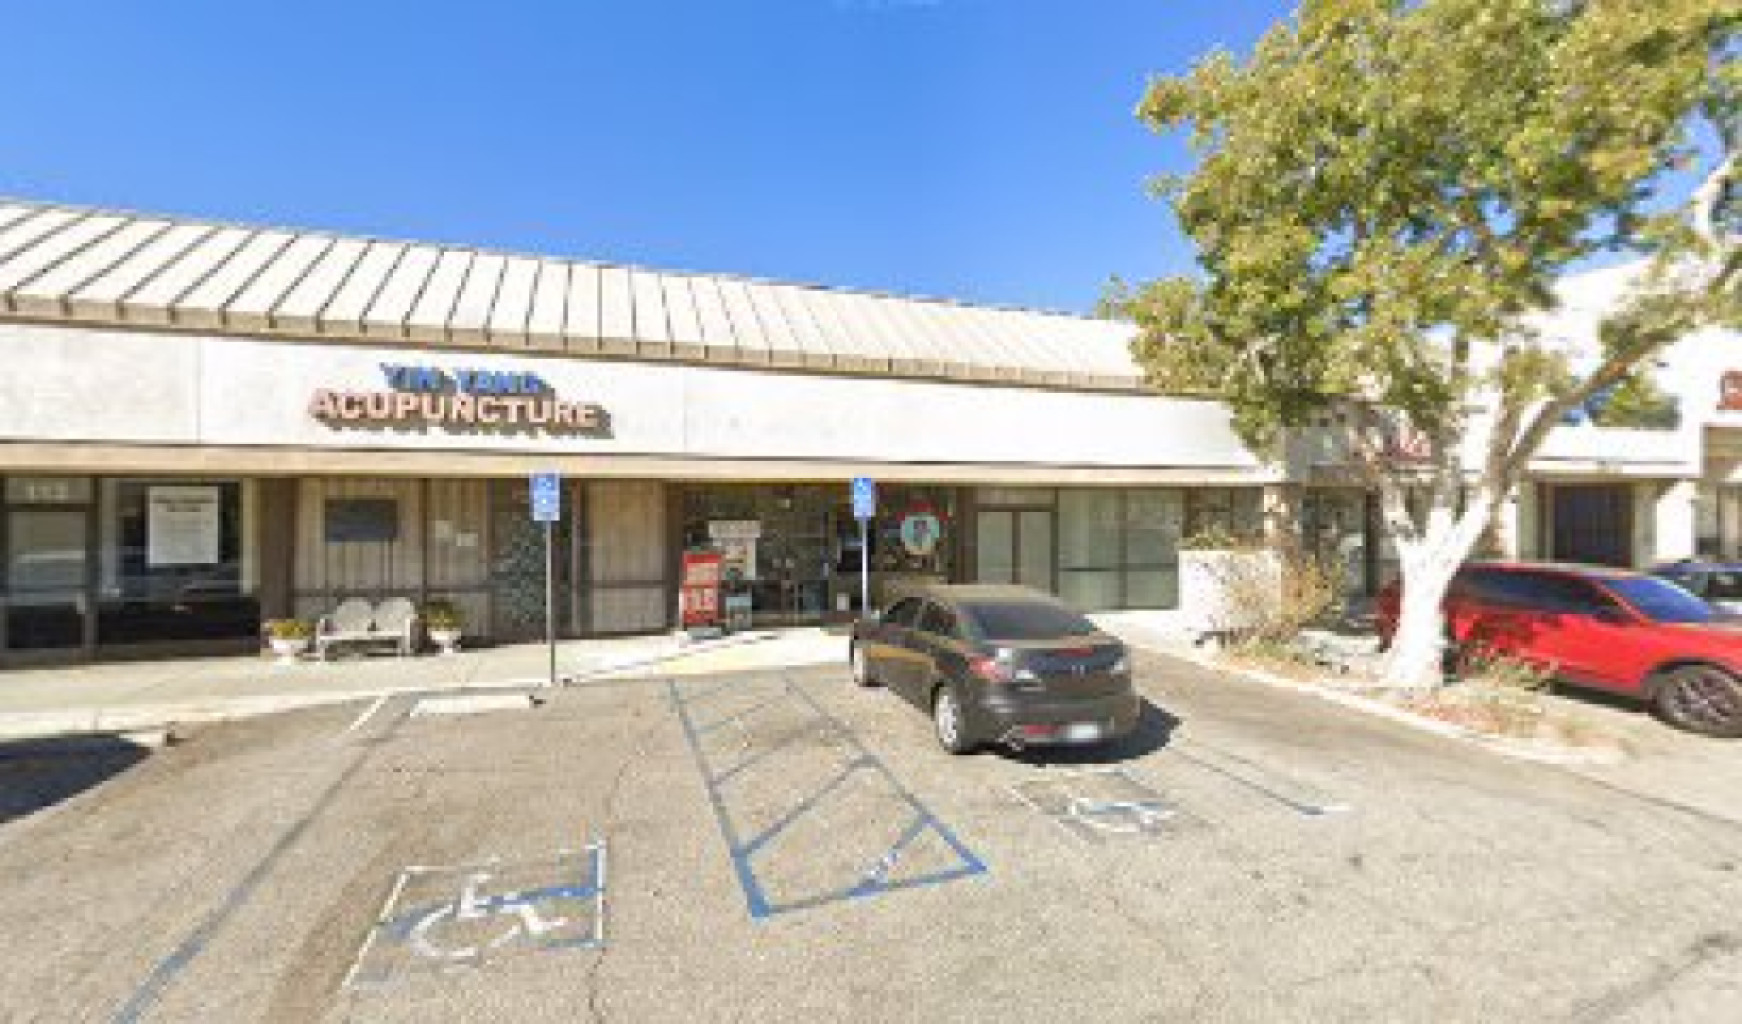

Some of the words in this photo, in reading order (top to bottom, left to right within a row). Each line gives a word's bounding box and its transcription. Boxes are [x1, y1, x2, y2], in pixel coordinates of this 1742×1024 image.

[379, 361, 446, 391] YIN
[456, 365, 546, 396] YANG
[309, 388, 600, 427] ACUPUNCTURE
